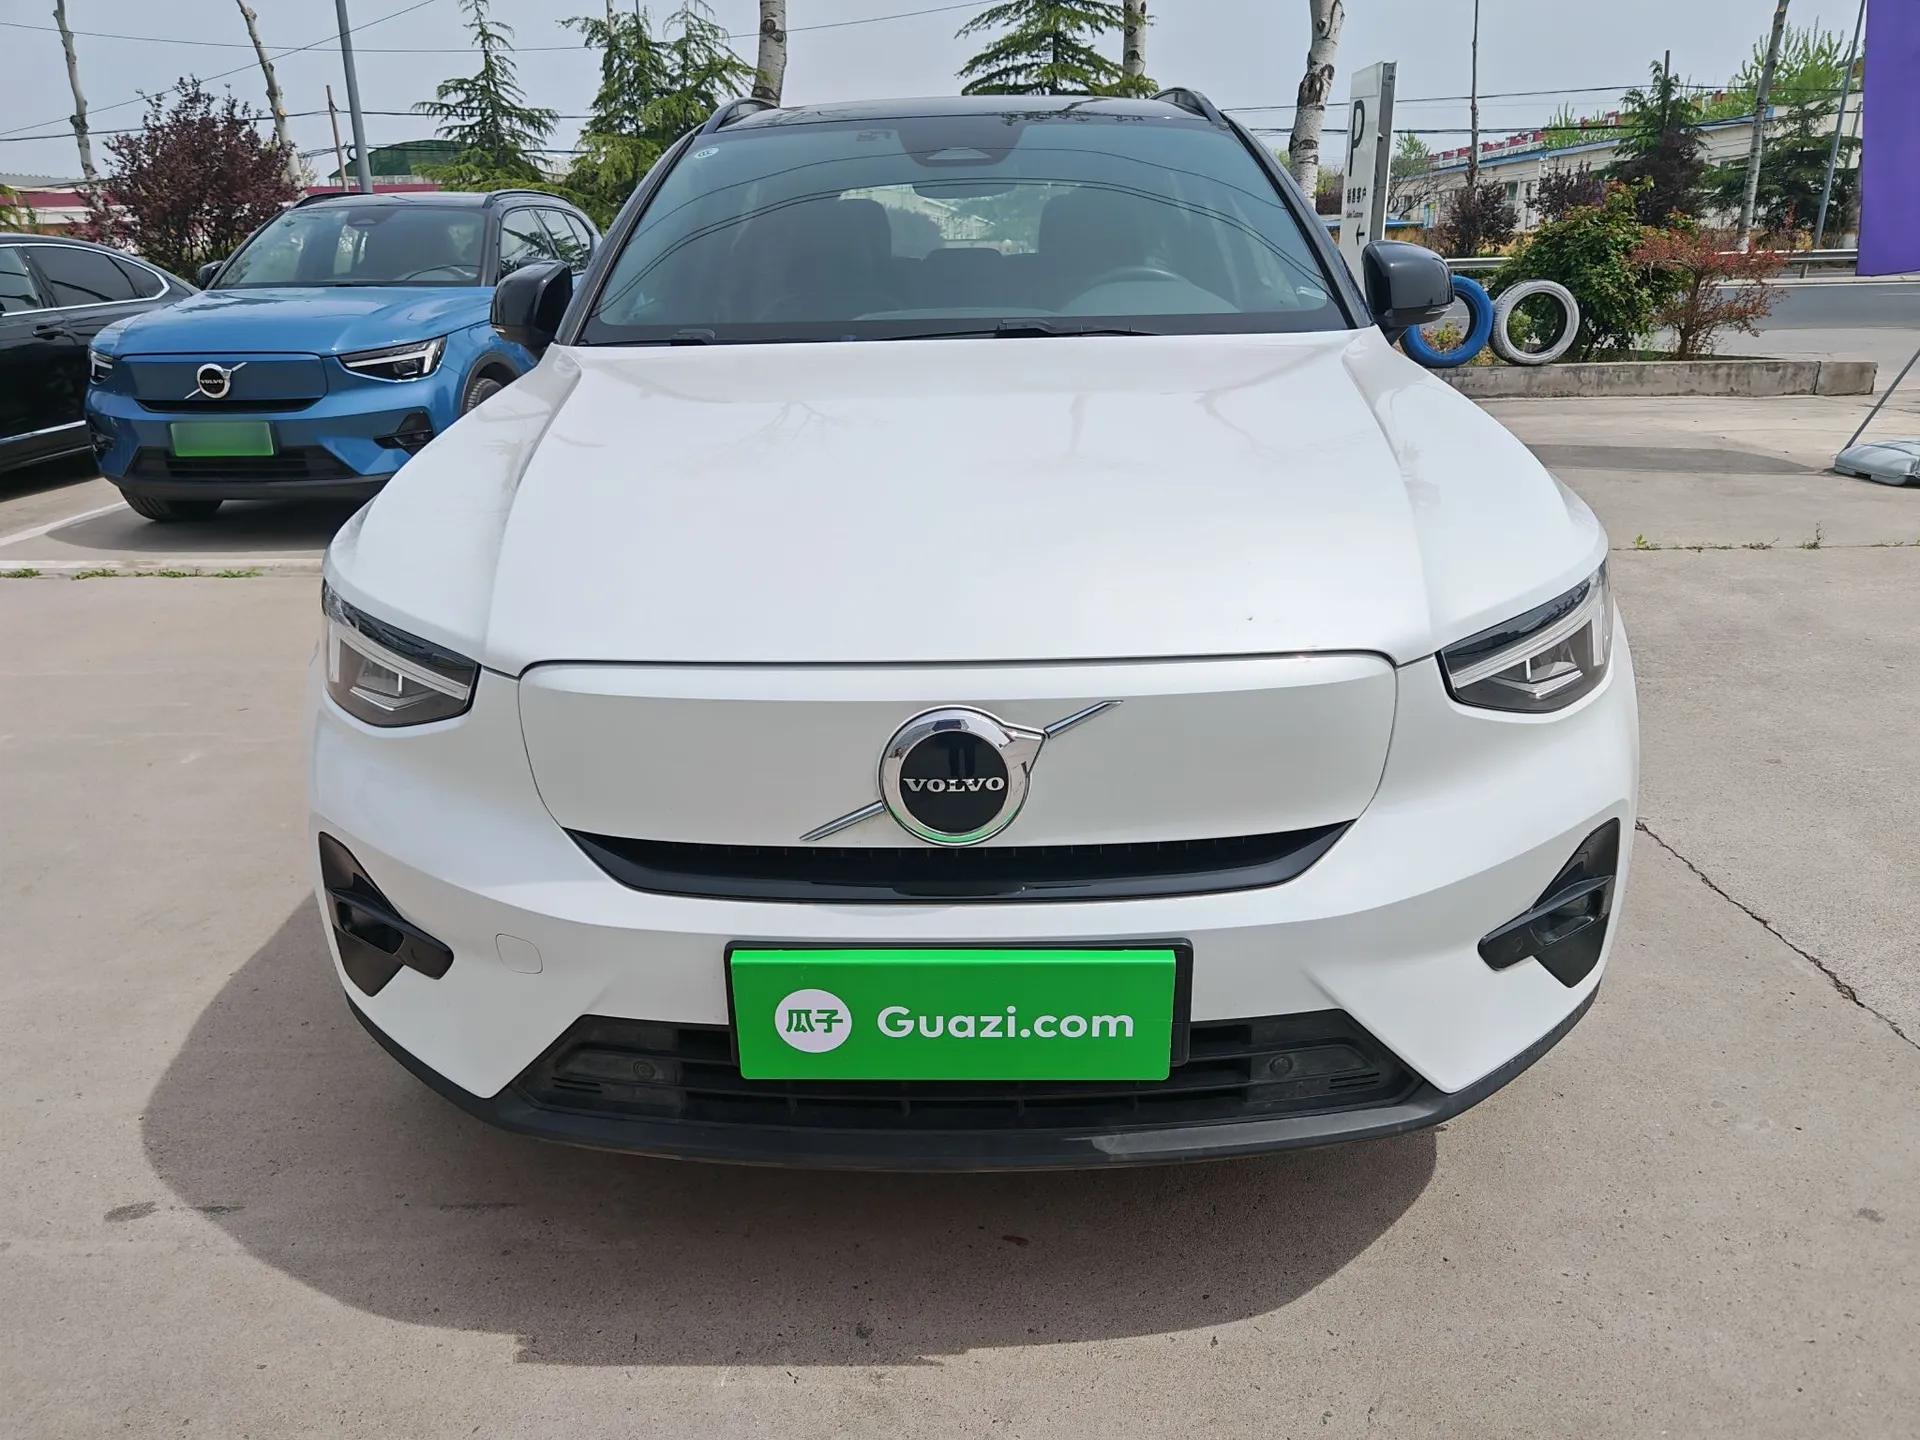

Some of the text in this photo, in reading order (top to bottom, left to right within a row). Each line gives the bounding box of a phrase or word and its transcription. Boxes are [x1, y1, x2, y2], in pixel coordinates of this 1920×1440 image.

[1348, 99, 1365, 177] P
[902, 776, 1005, 793] VOLVO
[786, 1008, 844, 1034] 瓜子
[877, 1005, 1134, 1038] Guazi.com
